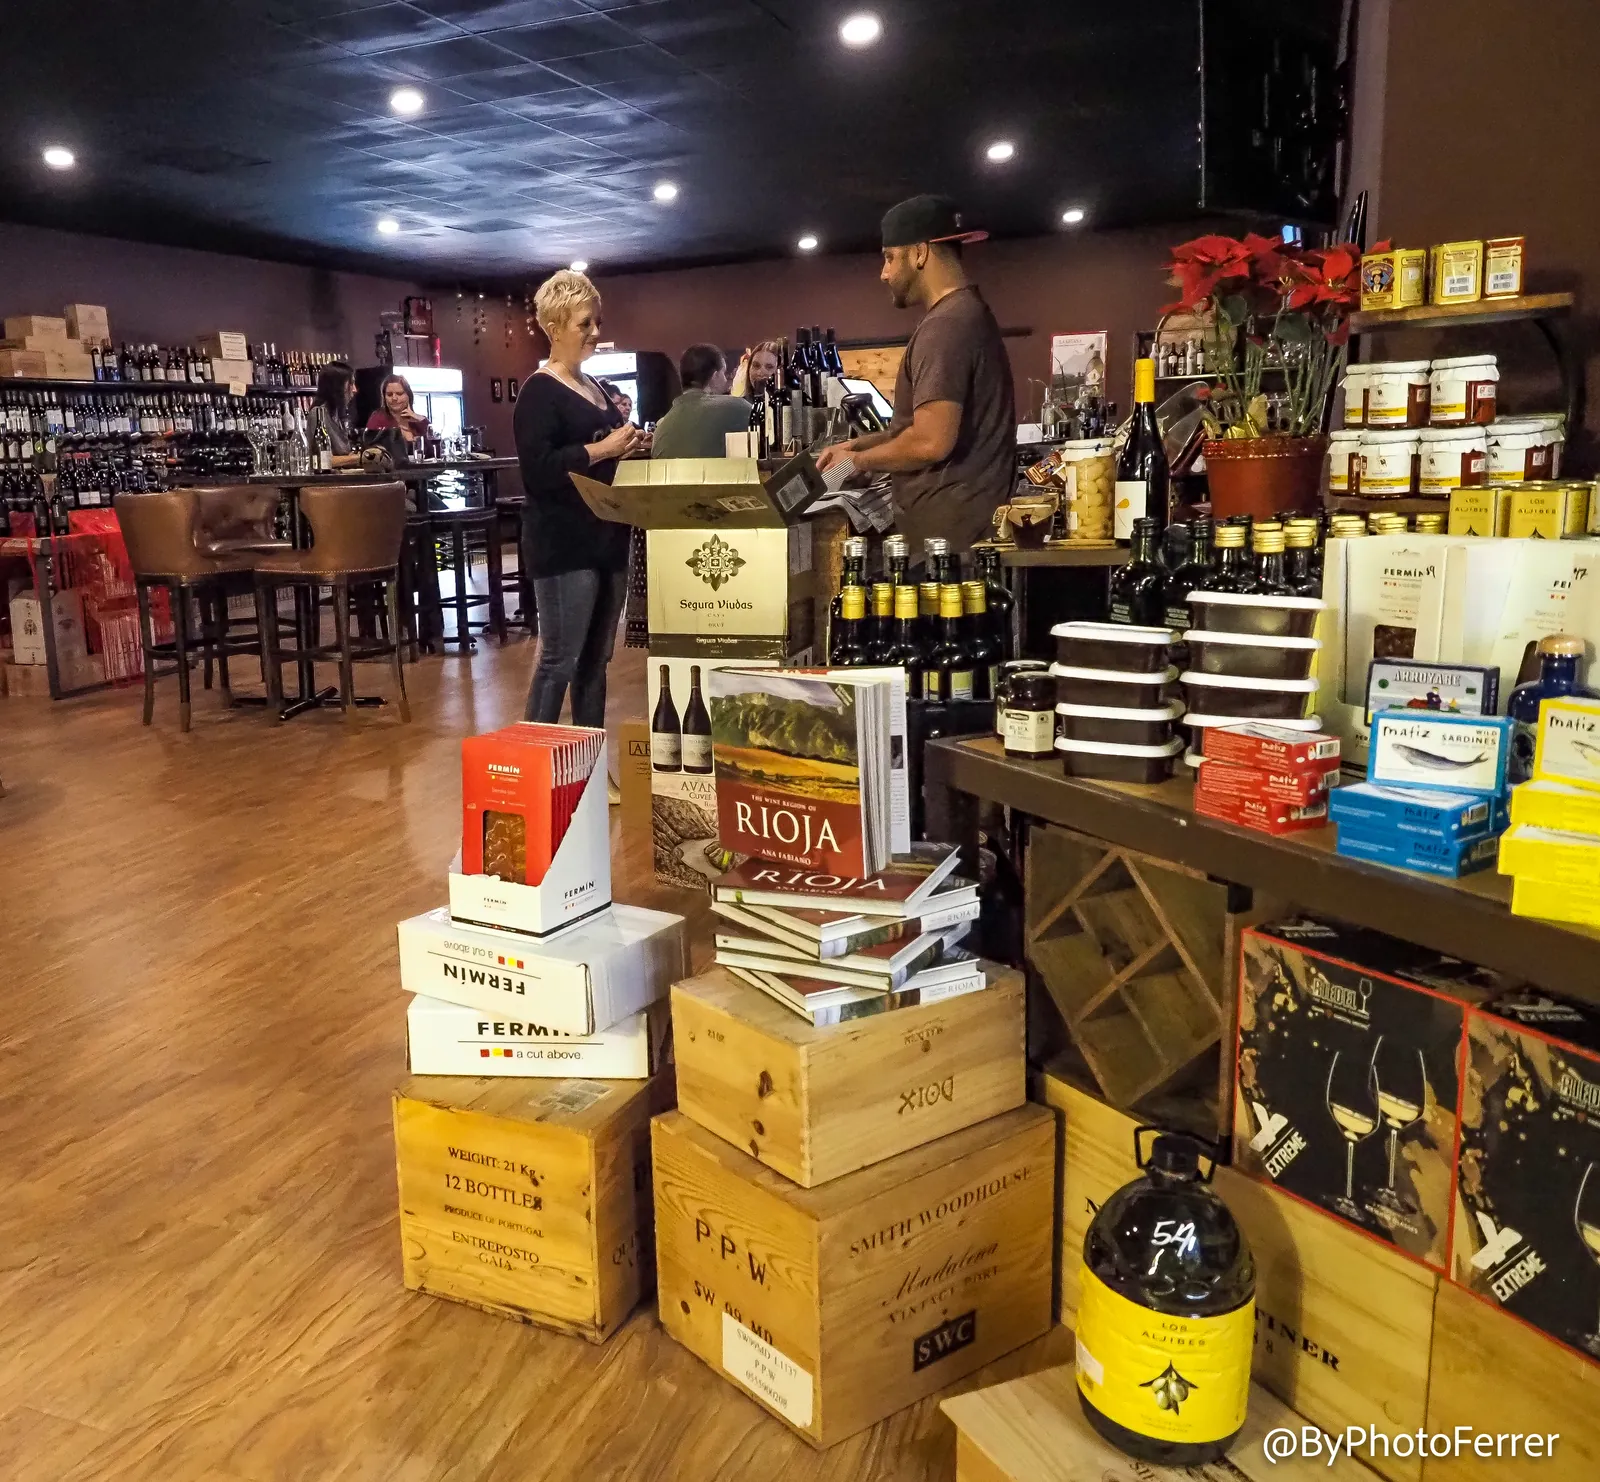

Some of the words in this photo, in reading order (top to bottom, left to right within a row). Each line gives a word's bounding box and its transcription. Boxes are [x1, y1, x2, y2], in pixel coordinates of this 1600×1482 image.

[680, 599, 714, 611] Segura
[717, 599, 753, 609] Viudas
[1442, 734, 1497, 745] SARDINES
[488, 764, 520, 774] FERMÍN
[764, 796, 781, 806] WINE
[735, 801, 842, 855] RIOJA
[761, 848, 776, 859] ANA
[778, 850, 812, 866] FABIANO
[752, 869, 887, 890] RIOJA
[564, 880, 595, 899] FERMÍN
[443, 940, 470, 954] above
[471, 946, 485, 957] cut
[443, 963, 526, 995] FERMÍN
[516, 1050, 523, 1059] a
[526, 1049, 544, 1059] cut
[547, 1049, 584, 1060] above.
[448, 1146, 501, 1170] WEIGHT:
[503, 1160, 516, 1173] 21
[1265, 1131, 1307, 1178] EXTREME
[445, 1173, 462, 1191] 12
[444, 1204, 484, 1223] PRODUCE
[498, 1219, 545, 1238] PORTUGAL
[848, 1218, 912, 1259] SMITH
[918, 1166, 1032, 1226] WOODHOUSE
[452, 1231, 540, 1264] ENTREPOSTO
[1491, 1250, 1547, 1302] EXTREME
[694, 1280, 715, 1306] SW
[751, 1320, 773, 1346] MD
[1162, 1322, 1188, 1331] LOS
[918, 1319, 973, 1362] SWC
[1141, 1330, 1206, 1346] ALJIBES
